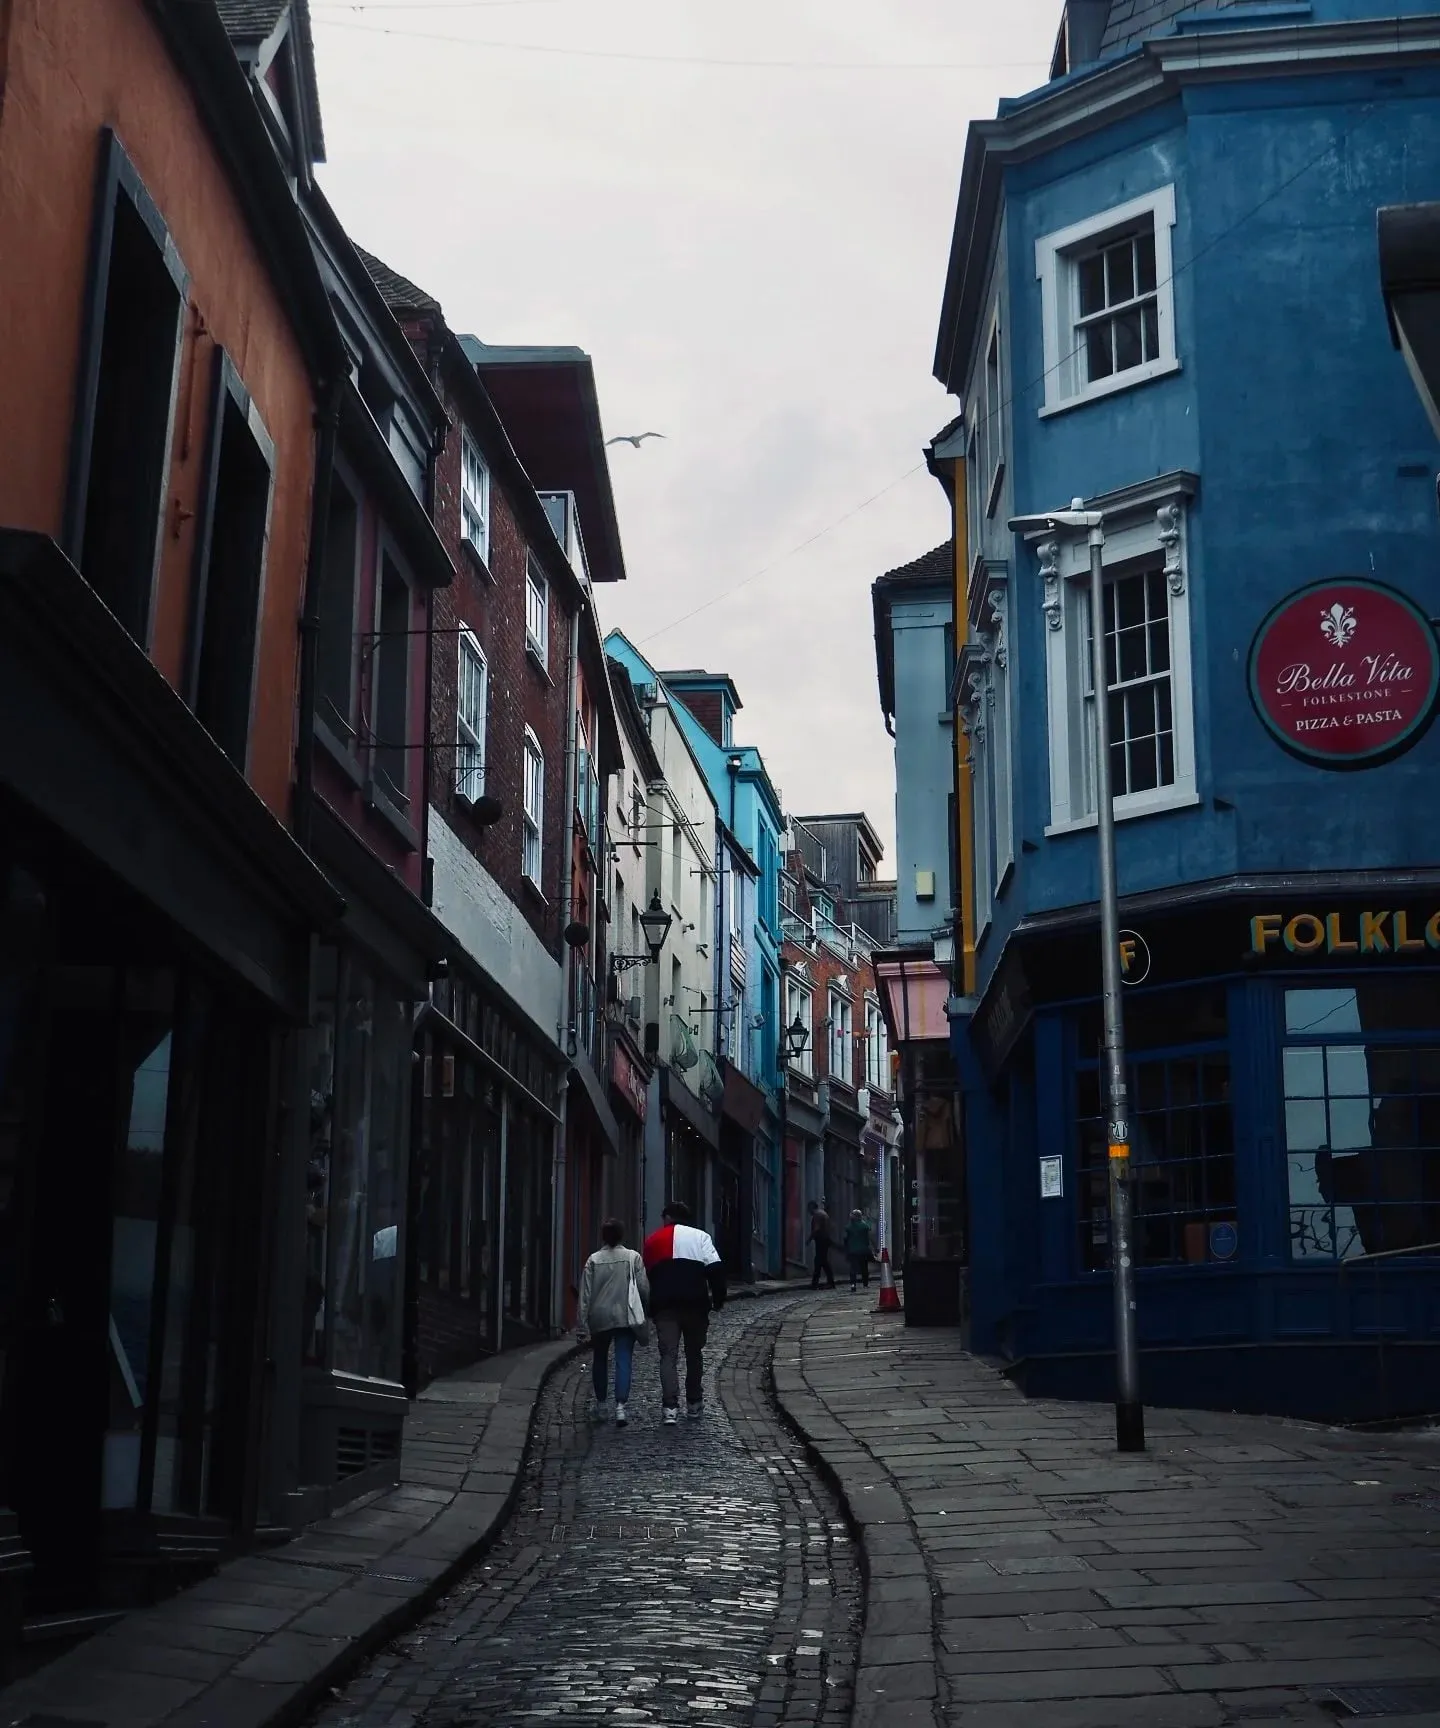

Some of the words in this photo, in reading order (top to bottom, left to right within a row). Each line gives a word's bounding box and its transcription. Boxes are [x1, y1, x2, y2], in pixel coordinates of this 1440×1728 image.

[1276, 663, 1356, 694] Bella
[1360, 652, 1415, 684] Vita
[1303, 688, 1392, 707] FOLKESTONE
[1296, 717, 1339, 731] PIZZA
[1343, 714, 1353, 725] &
[1357, 709, 1402, 725] PASTA
